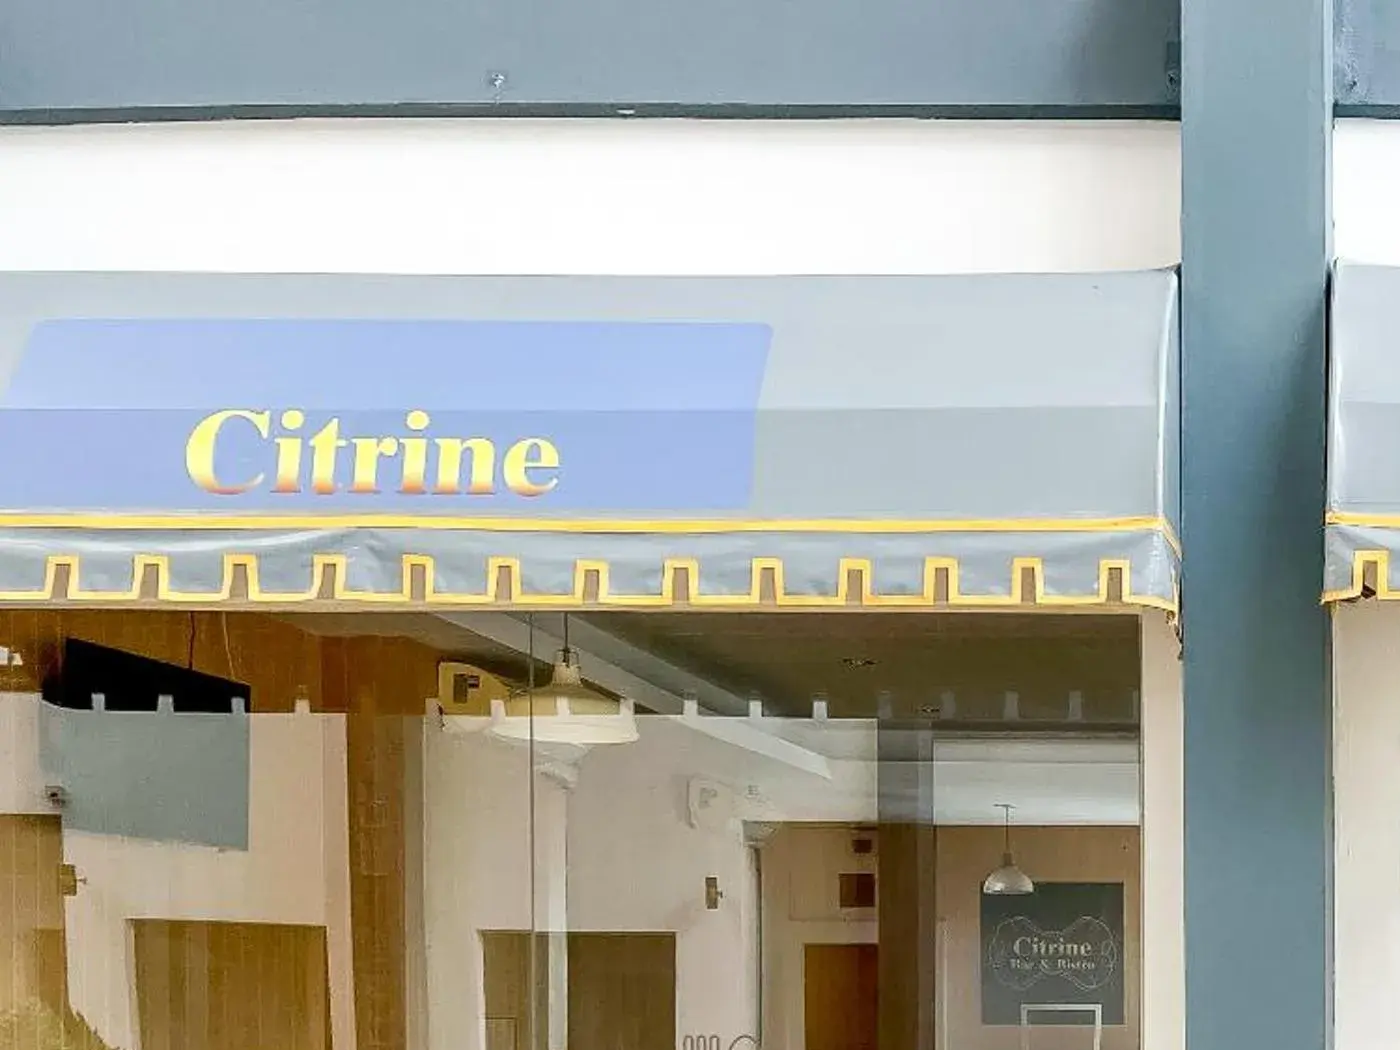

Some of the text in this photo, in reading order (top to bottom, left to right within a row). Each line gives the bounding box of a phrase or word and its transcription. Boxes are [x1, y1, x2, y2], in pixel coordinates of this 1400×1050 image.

[185, 408, 561, 497] Citrine
[1013, 936, 1092, 957] Citrine
[1010, 958, 1034, 970] Bar
[1057, 958, 1096, 970] Bistro
